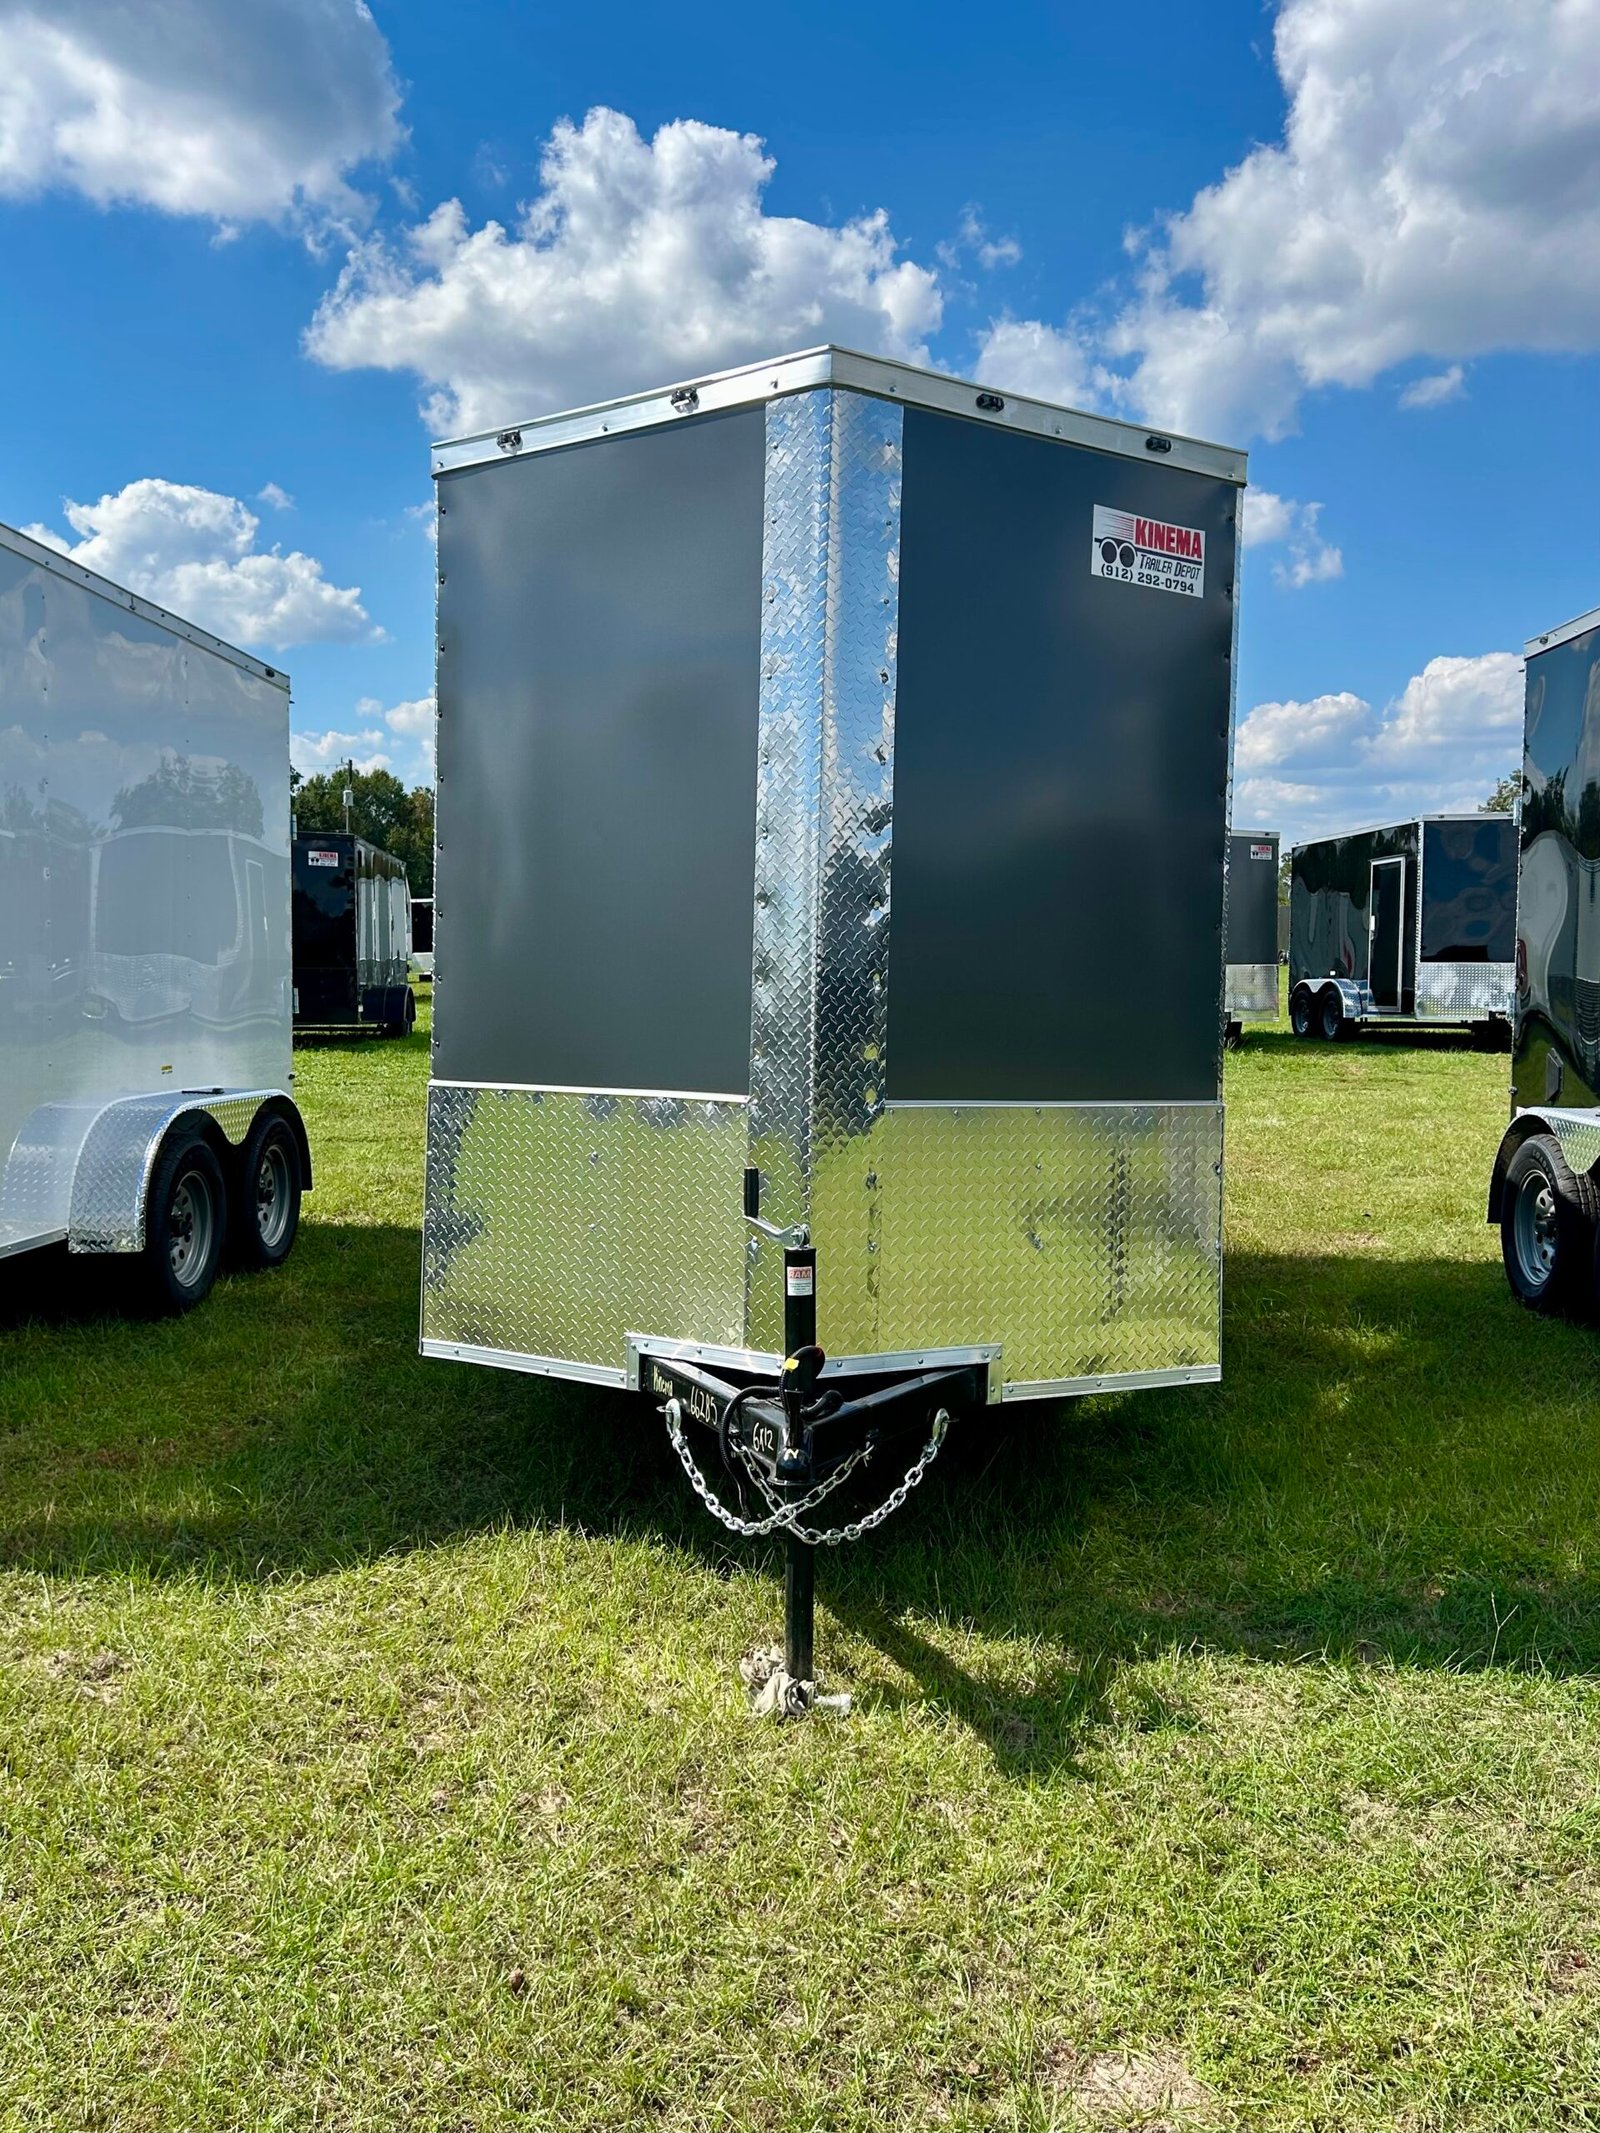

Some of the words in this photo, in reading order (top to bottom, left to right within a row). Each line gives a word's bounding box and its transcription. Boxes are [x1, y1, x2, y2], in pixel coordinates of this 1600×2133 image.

[1135, 518, 1202, 559] KINEMA
[1101, 563, 1133, 582] (912)
[1137, 572, 1195, 593] 292-0794
[690, 1385, 718, 1425] 66285
